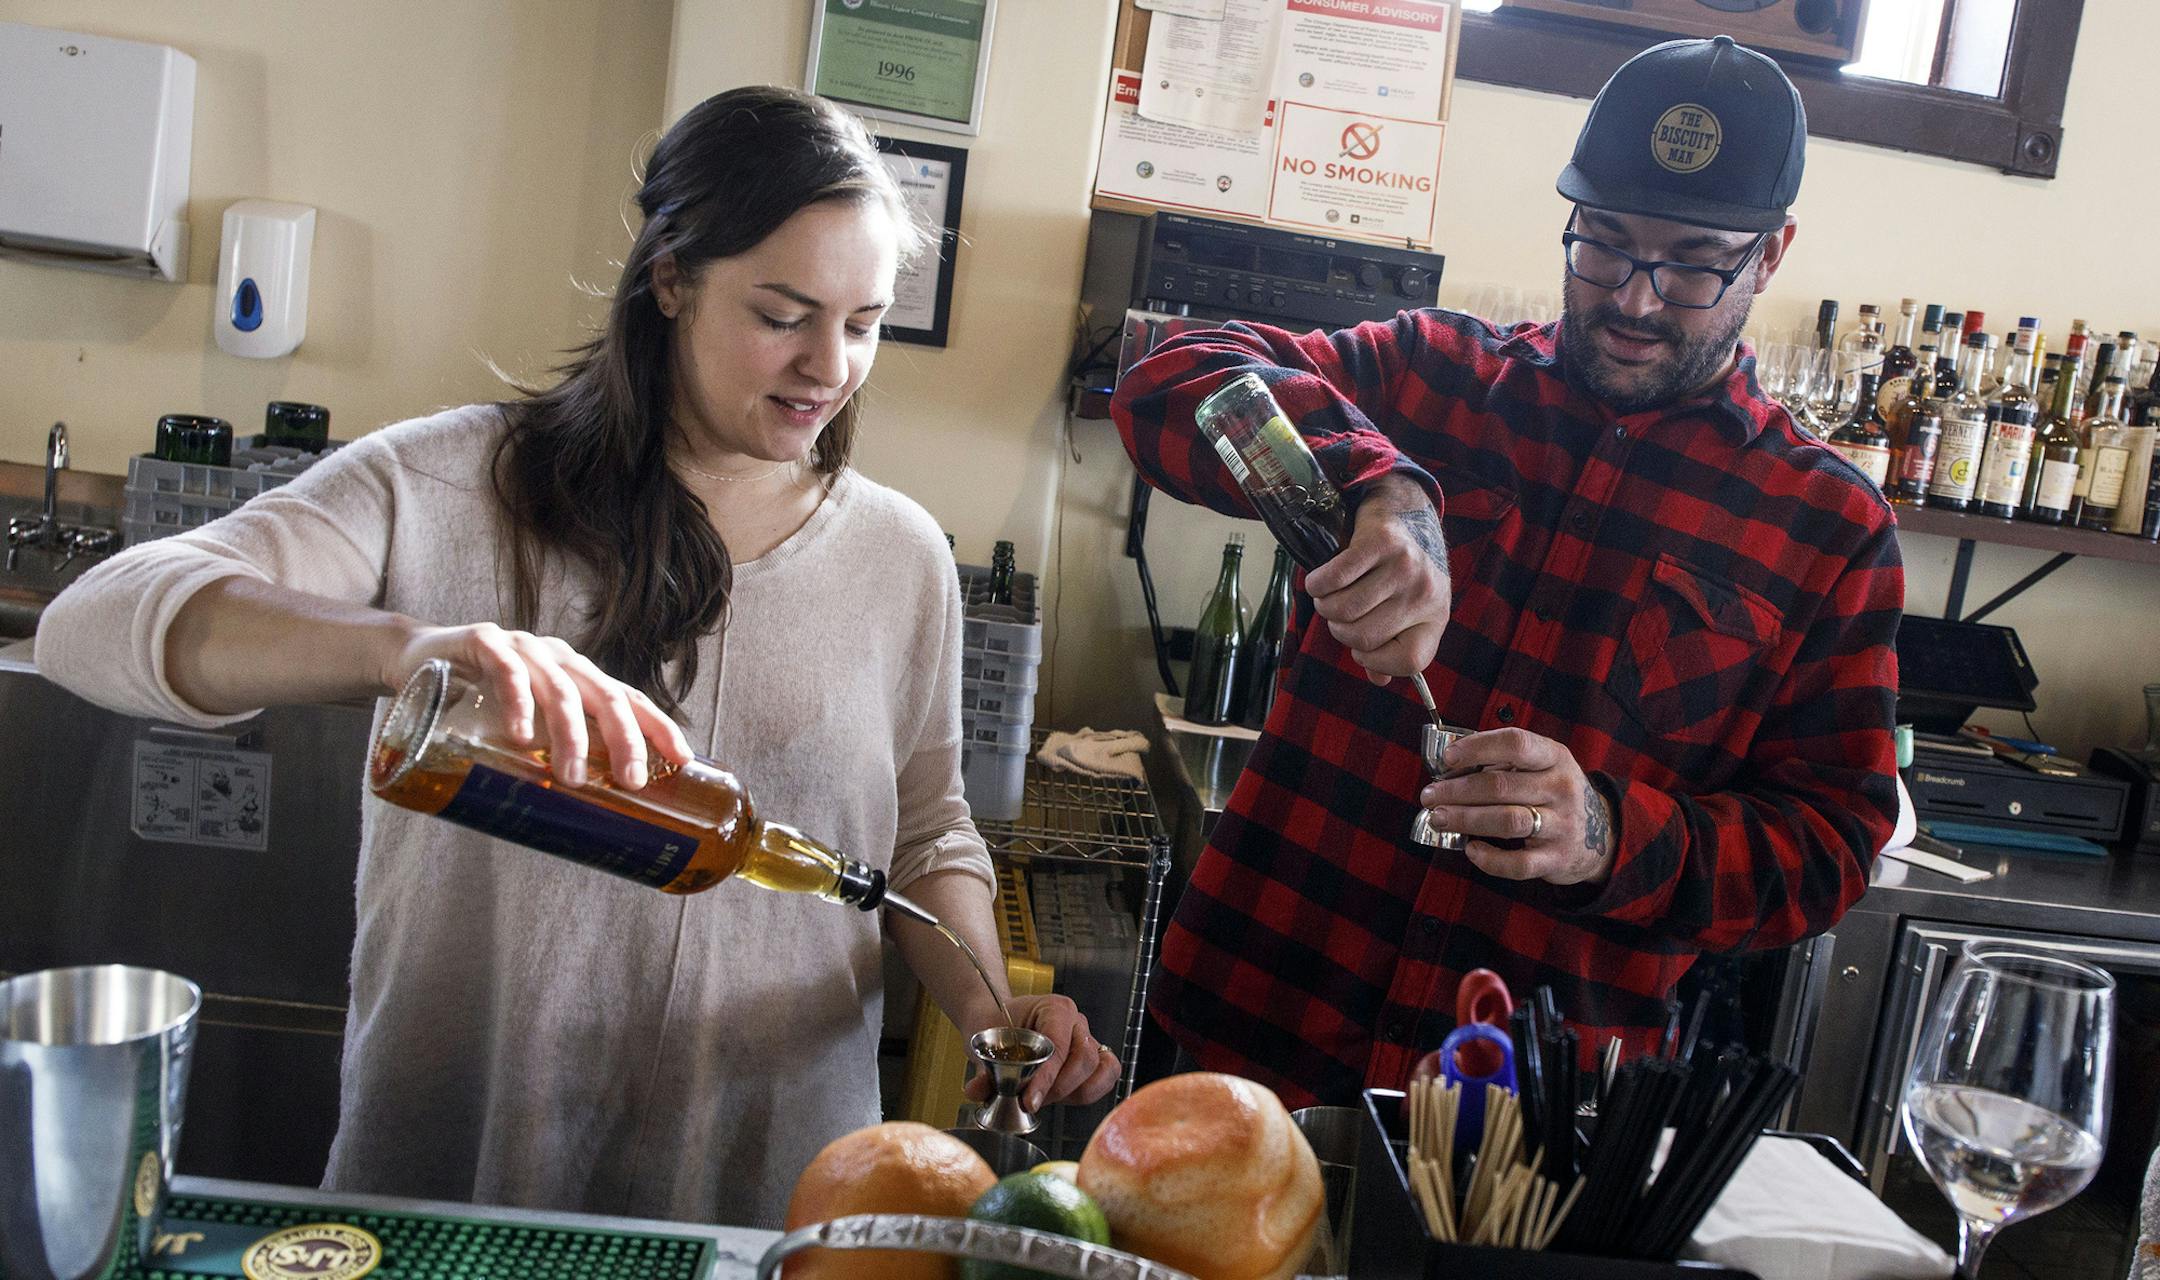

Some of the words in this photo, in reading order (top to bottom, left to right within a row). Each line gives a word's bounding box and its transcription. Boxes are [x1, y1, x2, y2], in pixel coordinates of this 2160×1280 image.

[1293, 0, 1369, 14] ONSUMER
[1372, 7, 1438, 25] ADVISORY
[877, 61, 916, 81] 1996
[1680, 111, 1703, 128] THE
[1659, 125, 1715, 150] BISCUIT
[1668, 147, 1695, 164] MAN
[1282, 156, 1316, 175] NO
[1324, 163, 1431, 192] SMOKING
[1924, 773, 1966, 786] Breadcrumb
